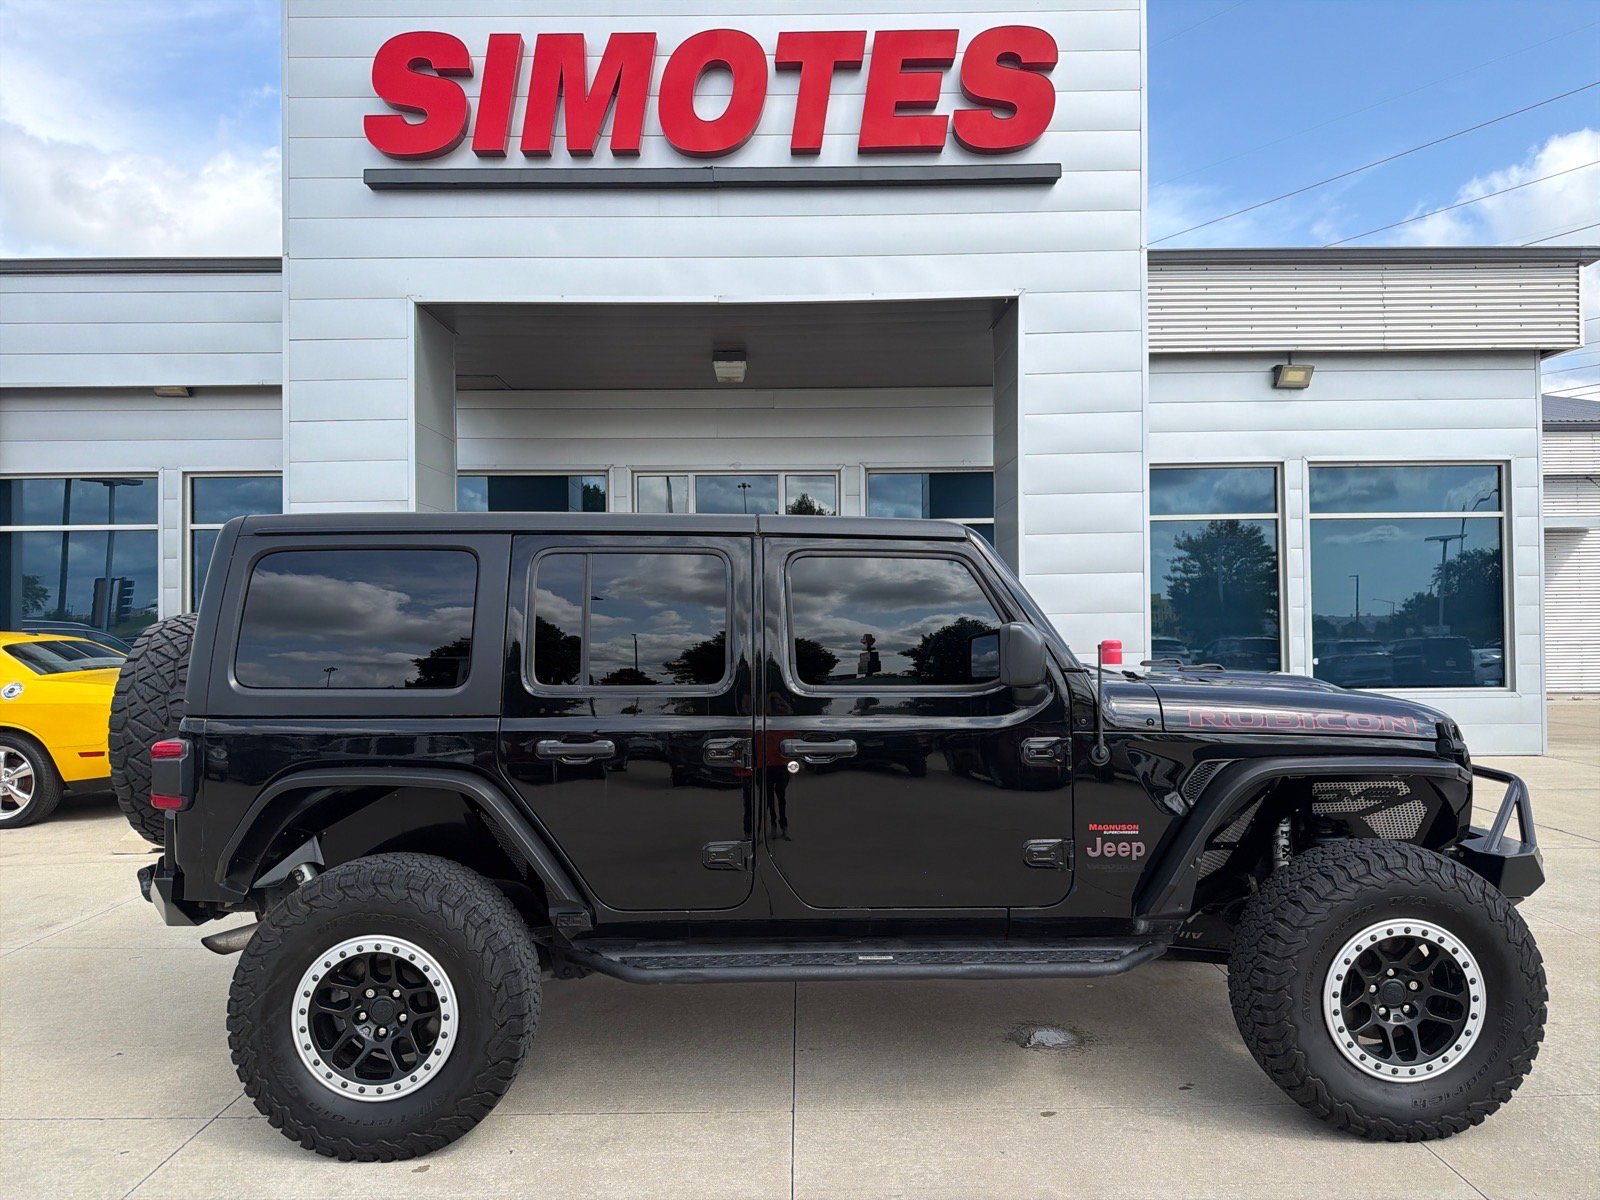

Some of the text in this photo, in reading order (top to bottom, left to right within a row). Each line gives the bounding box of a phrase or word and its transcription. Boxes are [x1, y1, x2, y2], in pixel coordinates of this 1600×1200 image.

[363, 25, 1058, 160] SIMOTES
[1188, 710, 1418, 733] RUBICON
[1088, 823, 1139, 831] MAGNUSON
[1086, 837, 1146, 861] Jeep
